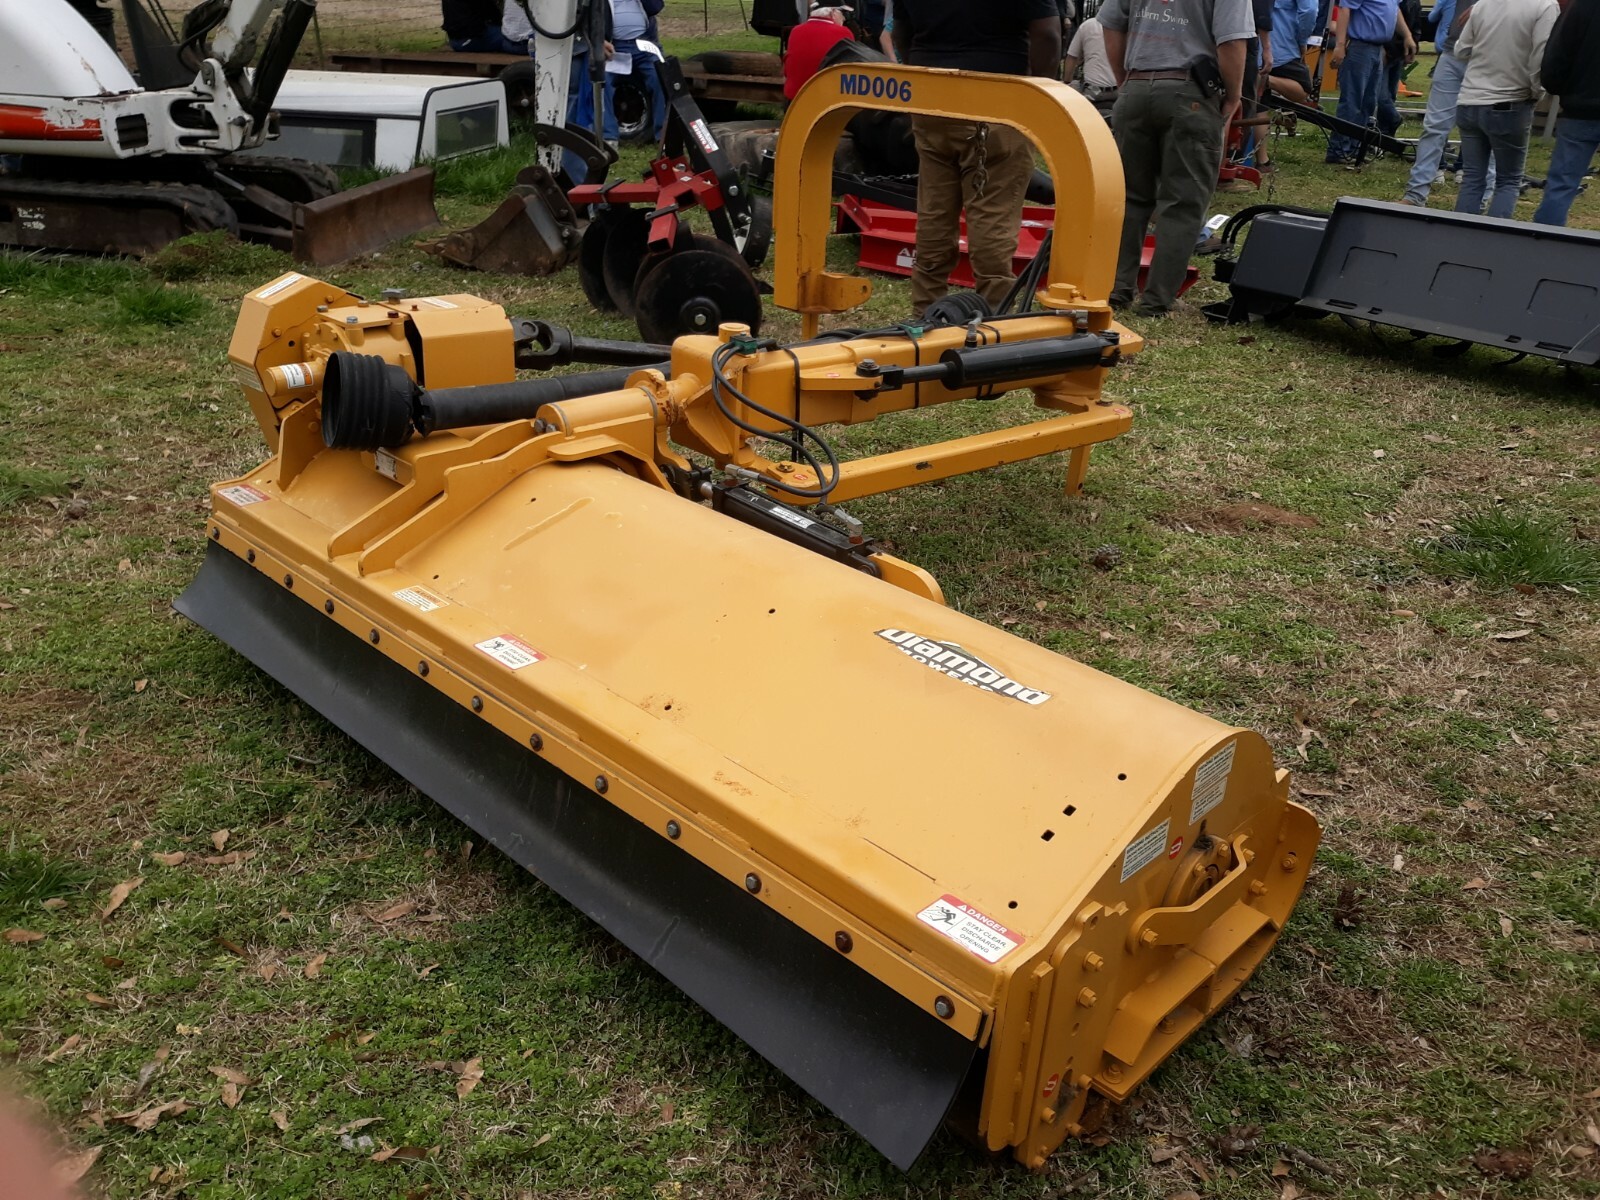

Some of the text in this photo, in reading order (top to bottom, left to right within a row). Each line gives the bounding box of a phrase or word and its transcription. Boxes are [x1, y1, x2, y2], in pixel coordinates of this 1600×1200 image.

[840, 73, 912, 102] MD006
[966, 908, 1008, 934] DANGER
[966, 921, 983, 933] STAY
[959, 933, 990, 954] OPENING
[961, 926, 1002, 951] DISCHARGE
